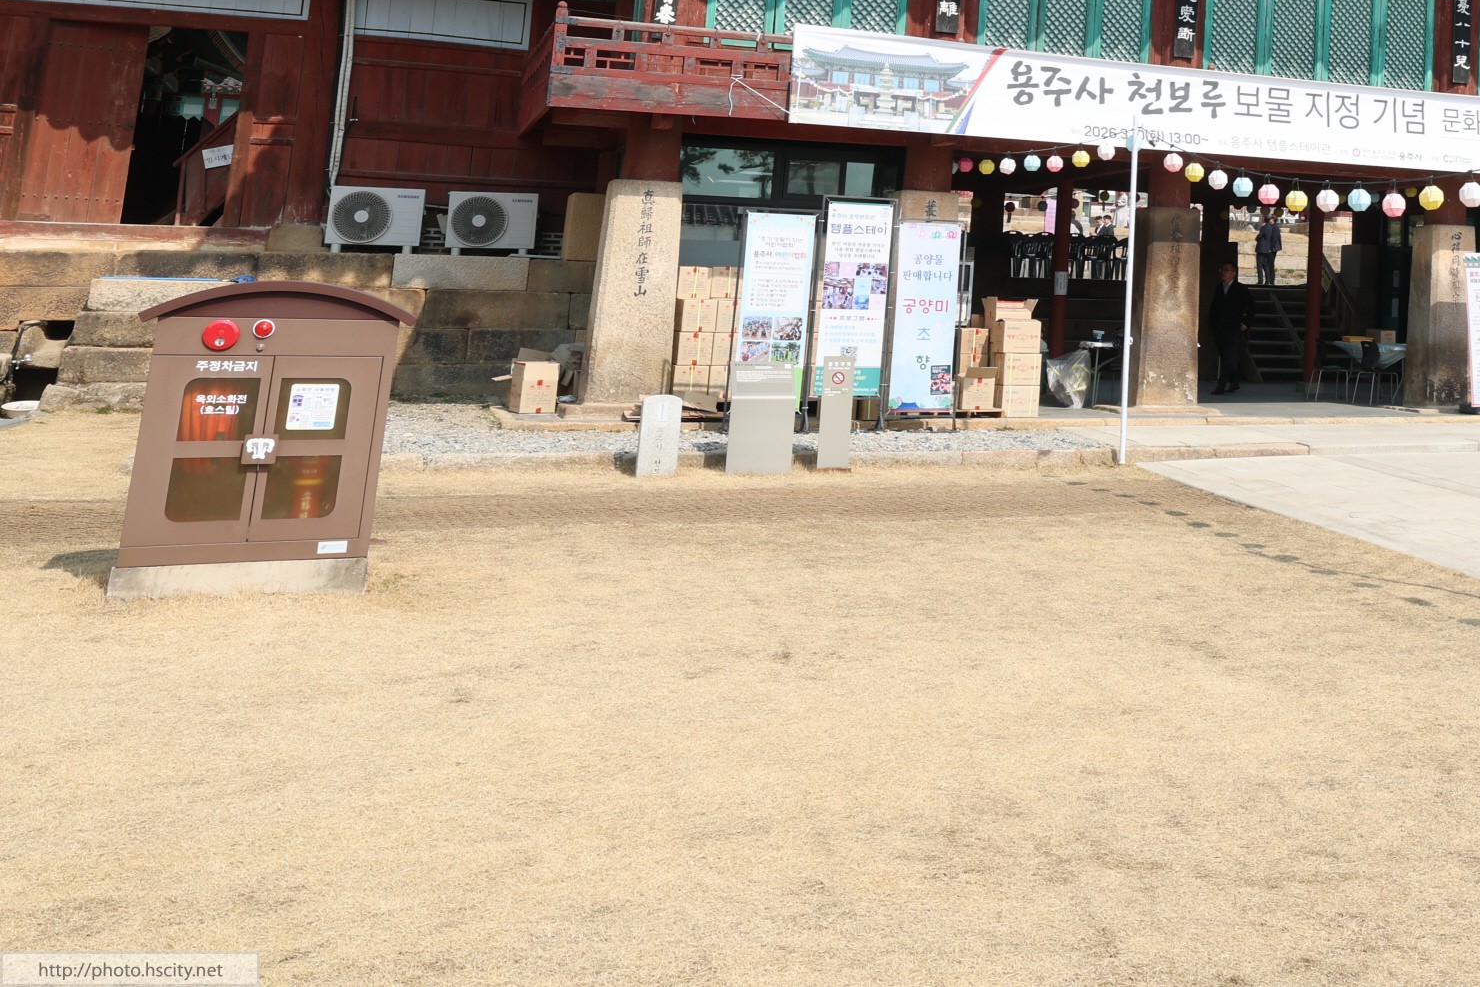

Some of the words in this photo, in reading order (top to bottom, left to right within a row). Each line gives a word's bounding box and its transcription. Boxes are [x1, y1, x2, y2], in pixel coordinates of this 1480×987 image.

[1007, 60, 1114, 107] 용주사
[1127, 73, 1227, 119] 천보루
[1234, 85, 1293, 124] 보물
[1304, 91, 1361, 130] 지정
[1371, 95, 1427, 136] 기념
[1169, 131, 1209, 146] 13:00~
[1230, 135, 1263, 149] 용주사
[1267, 138, 1331, 156] 템플스테이관
[831, 223, 888, 235] 템플스테이
[913, 253, 944, 265] 공양물
[902, 270, 953, 282] 판매합니다
[902, 298, 949, 314] 공양미
[917, 327, 930, 341] 초
[195, 360, 258, 372] 주정차금지
[916, 355, 930, 370] 향
[194, 394, 247, 404] 옥외소화전
[199, 405, 240, 415] (호스릴)
